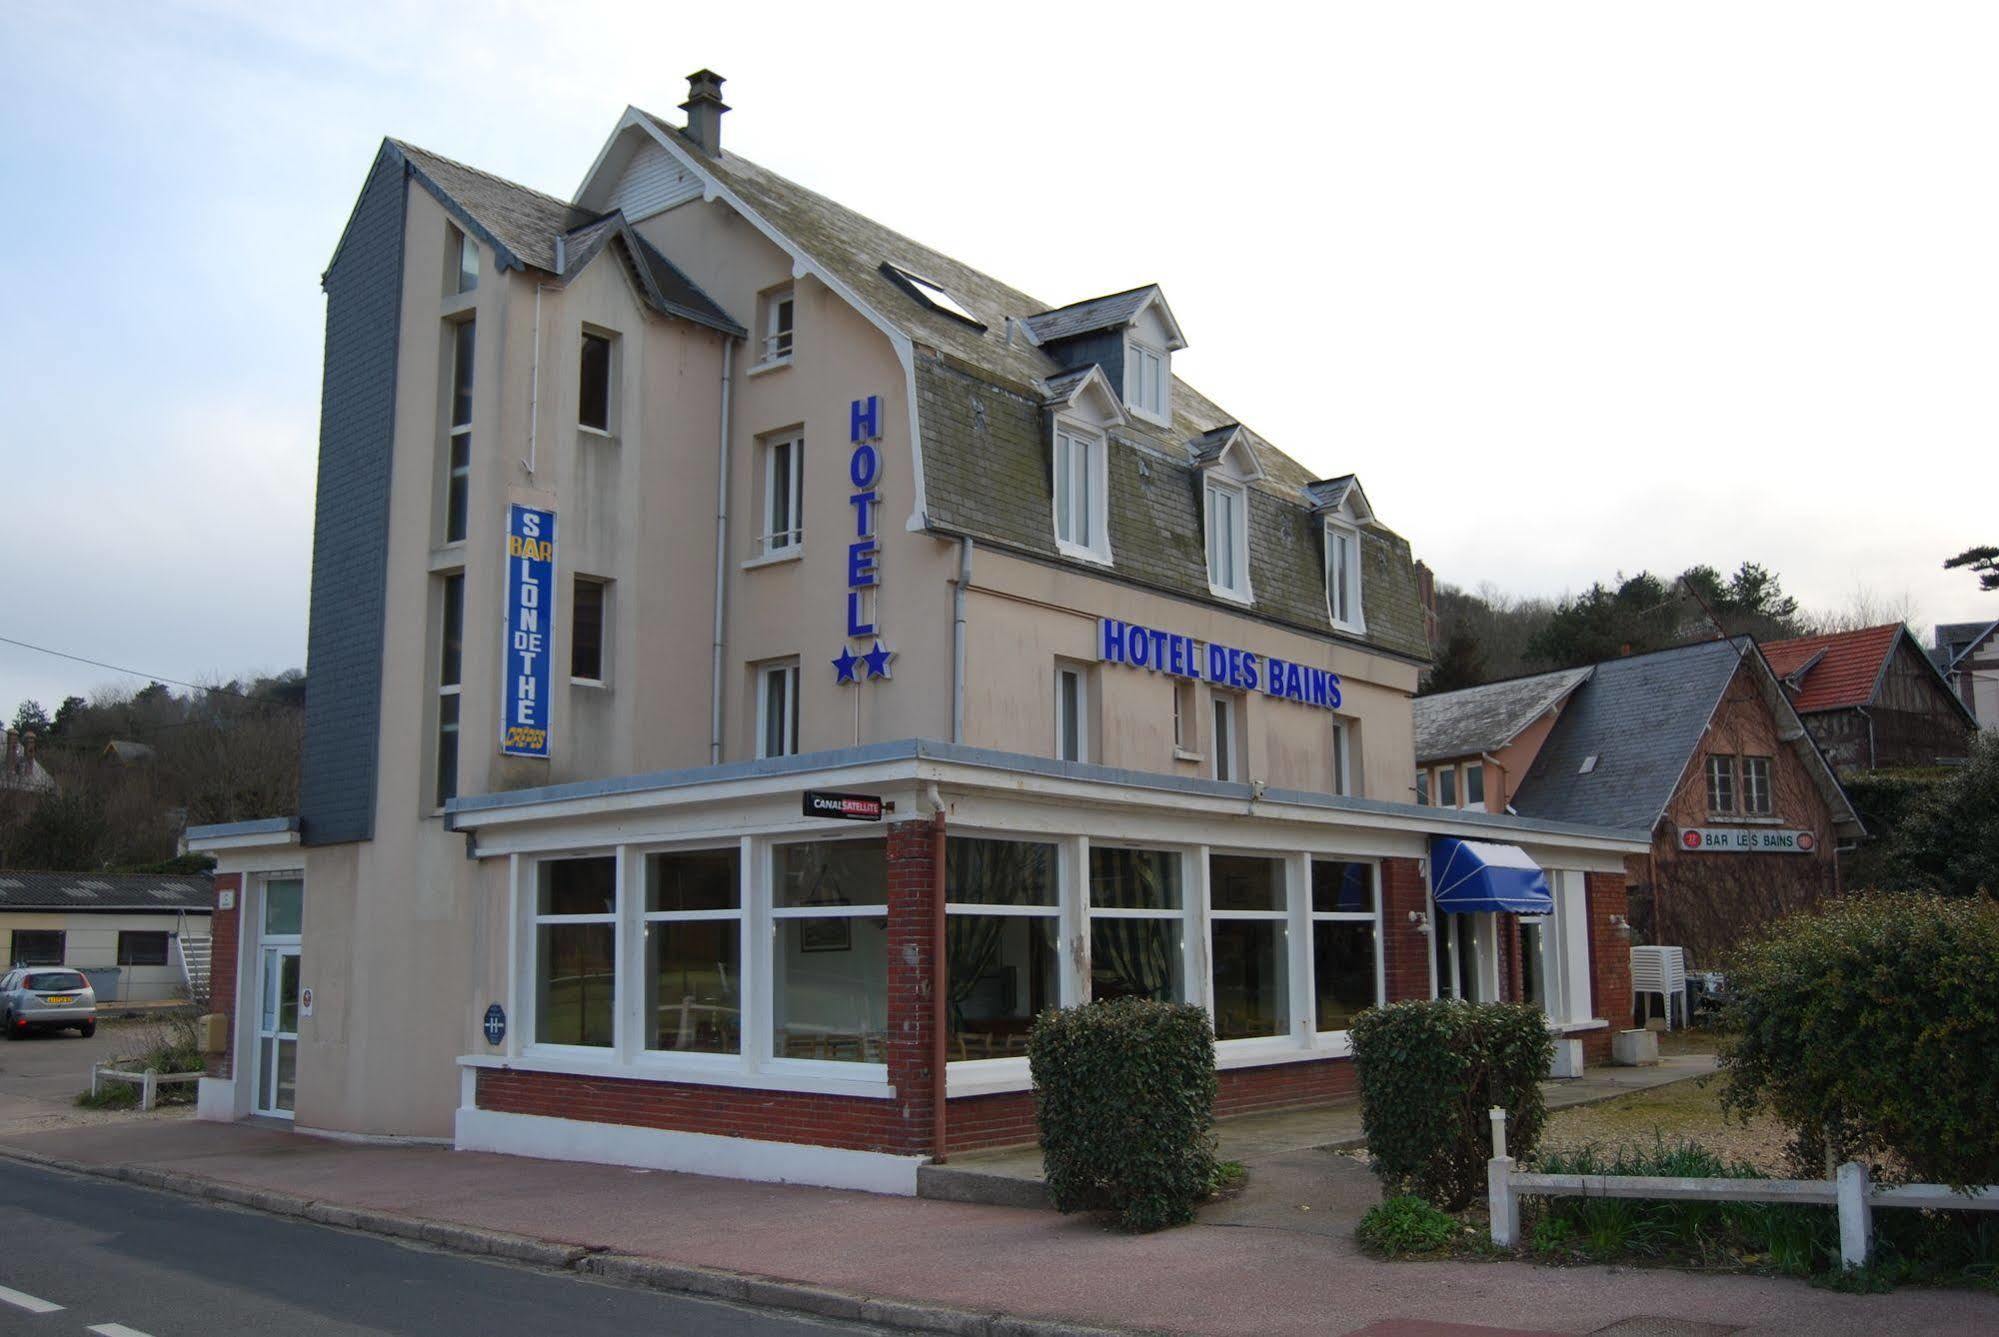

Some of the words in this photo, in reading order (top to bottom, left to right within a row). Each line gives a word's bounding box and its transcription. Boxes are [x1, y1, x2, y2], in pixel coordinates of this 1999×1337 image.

[848, 395, 880, 638] HOTEL
[511, 535, 553, 563] BAR
[514, 632, 542, 652] DE
[1103, 617, 1200, 679] HOTEL
[1208, 643, 1259, 690] DES
[1268, 657, 1342, 710] BAINS
[517, 651, 537, 725] THE
[1705, 834, 1728, 846] BAR
[1736, 834, 1758, 847] LES
[1763, 835, 1793, 847] BAINS
